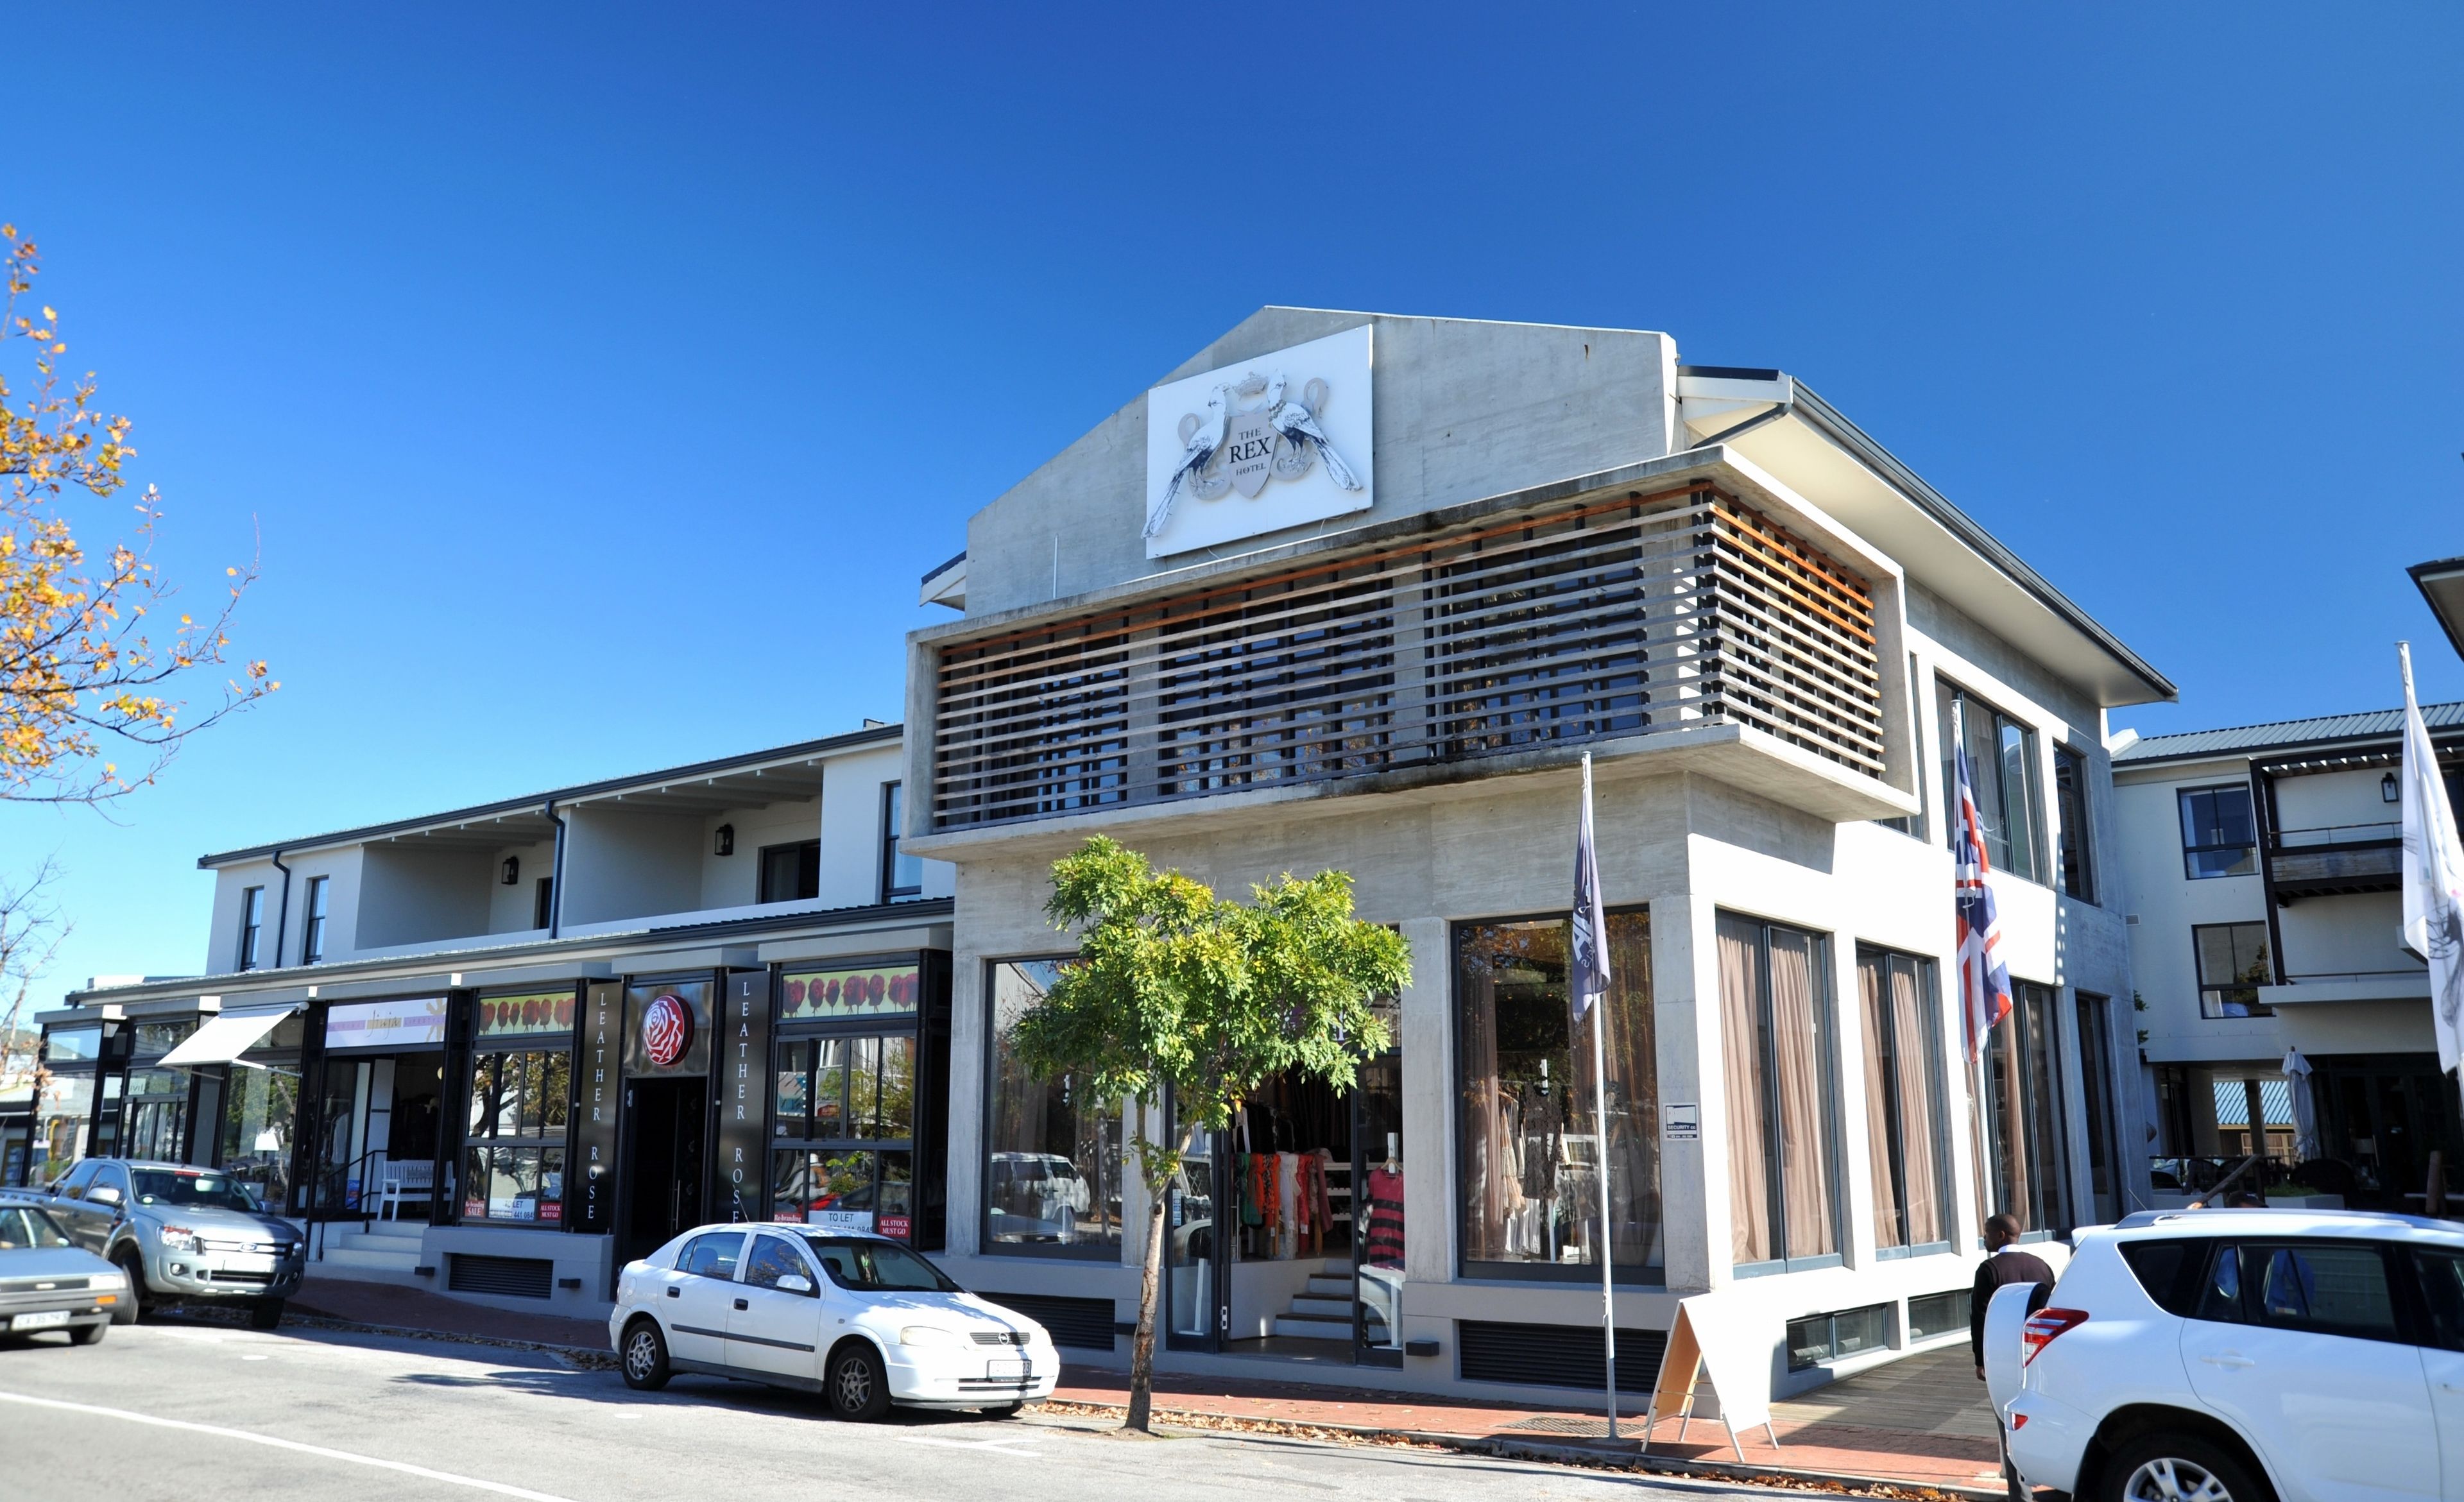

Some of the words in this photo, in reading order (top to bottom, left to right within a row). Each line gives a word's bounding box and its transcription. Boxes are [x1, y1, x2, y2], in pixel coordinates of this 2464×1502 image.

[1238, 427, 1262, 440] THE
[1229, 436, 1271, 464] REX
[1236, 463, 1267, 476] HOTEL
[593, 993, 606, 1121] LEATHER
[737, 982, 749, 1120] LEATHER
[588, 1147, 598, 1219] ROSE
[468, 1208, 481, 1216] SALE
[774, 1214, 801, 1222] Re-branding
[828, 1213, 838, 1222] TO
[840, 1213, 854, 1222] LET
